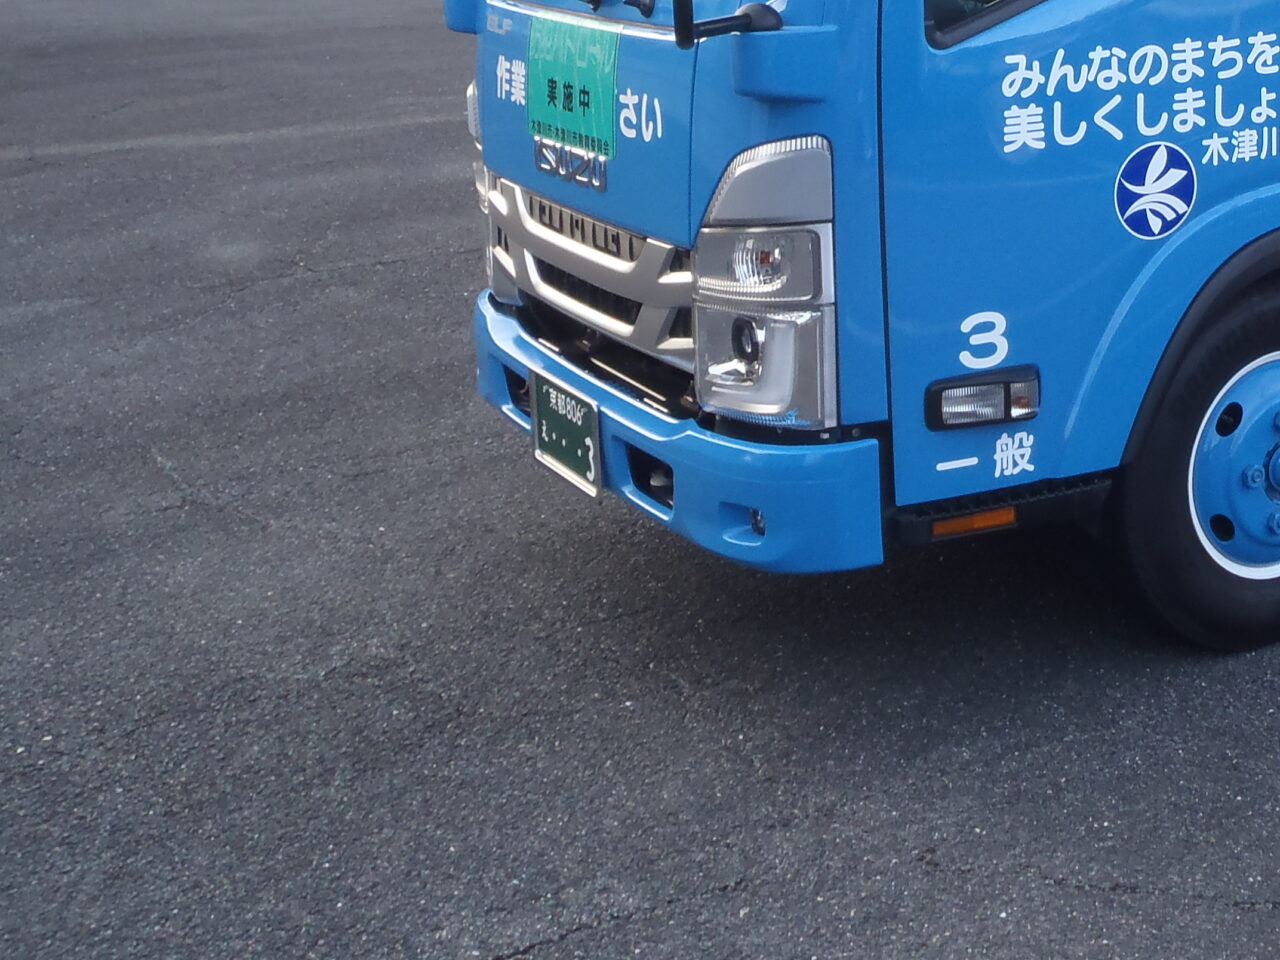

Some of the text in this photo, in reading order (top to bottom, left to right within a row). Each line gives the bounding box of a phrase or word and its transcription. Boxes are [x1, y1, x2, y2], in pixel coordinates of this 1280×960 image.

[1001, 30, 1280, 99] みんなのまちを
[496, 54, 663, 143] 作業 さい
[546, 77, 591, 117] 実施中
[958, 310, 1009, 369] 3
[935, 431, 1035, 478] 一般
